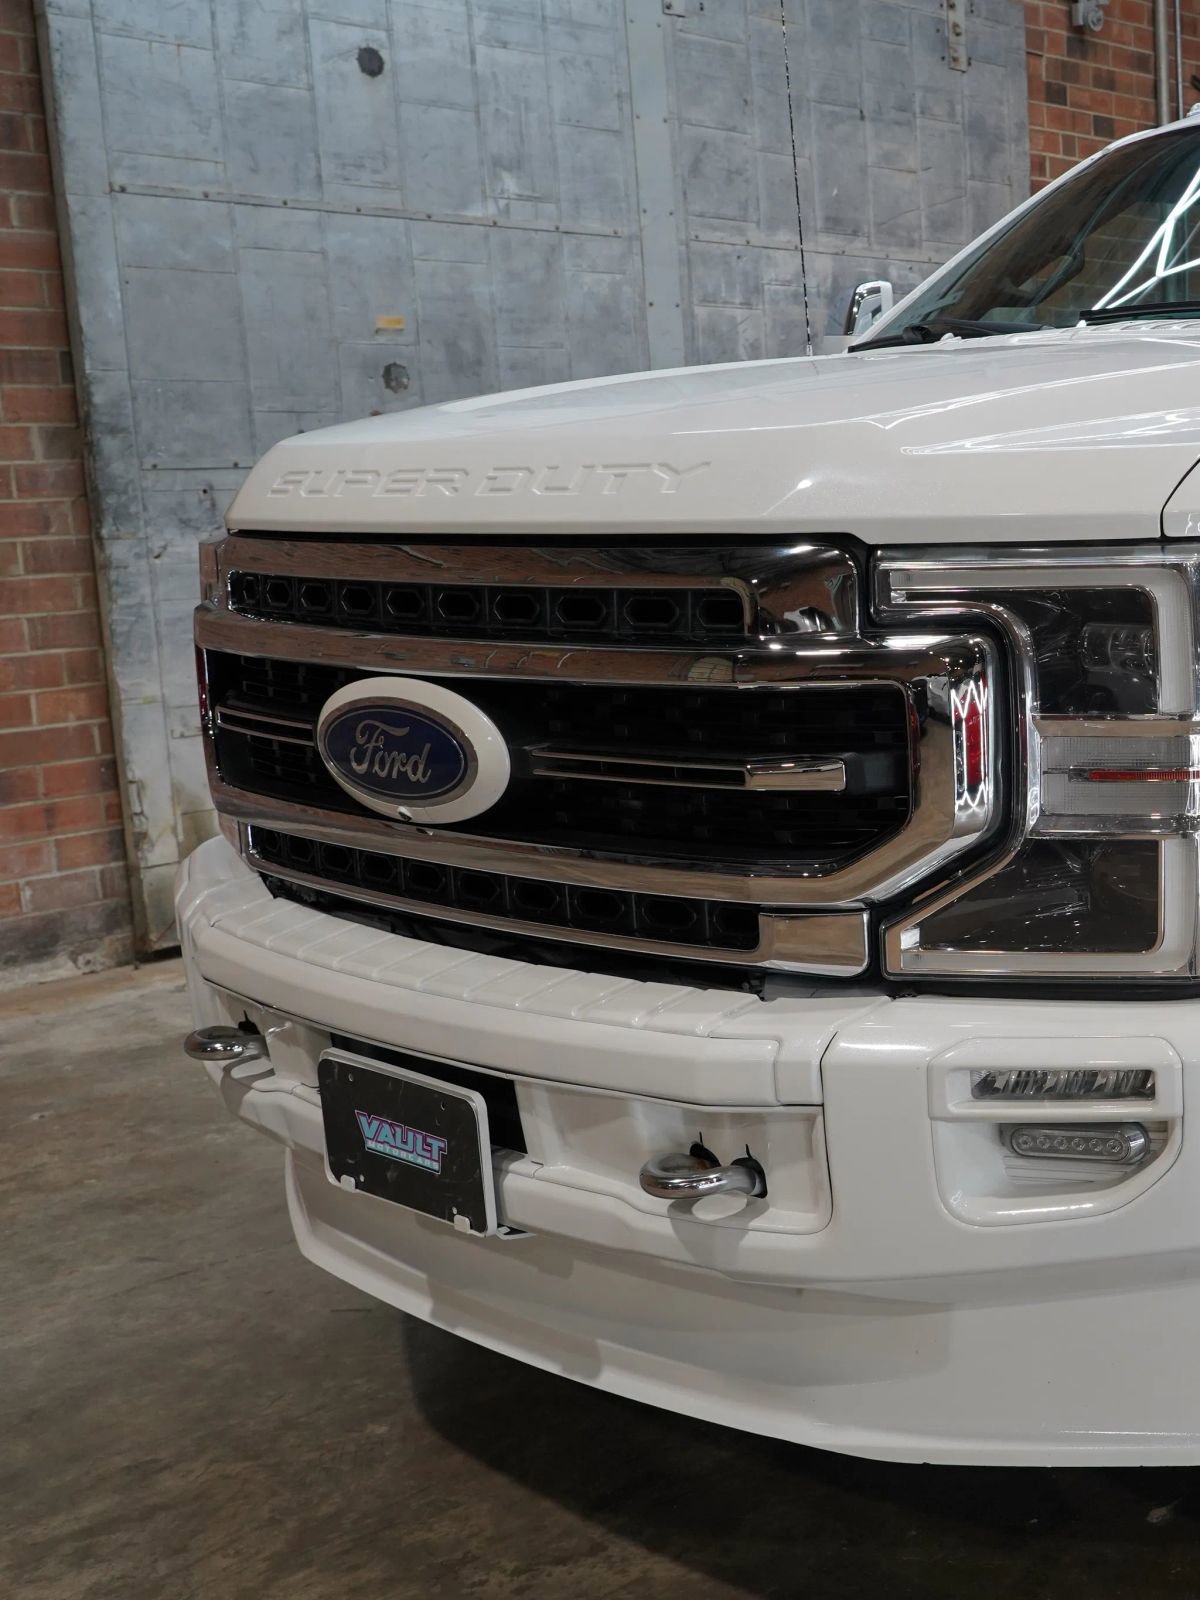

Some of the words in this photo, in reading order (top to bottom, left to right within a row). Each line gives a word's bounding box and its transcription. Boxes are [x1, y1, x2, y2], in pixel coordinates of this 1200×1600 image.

[267, 468, 470, 498] SUPER
[473, 461, 712, 497] DUTY
[349, 719, 432, 784] Ford
[356, 1111, 447, 1162] VAULT
